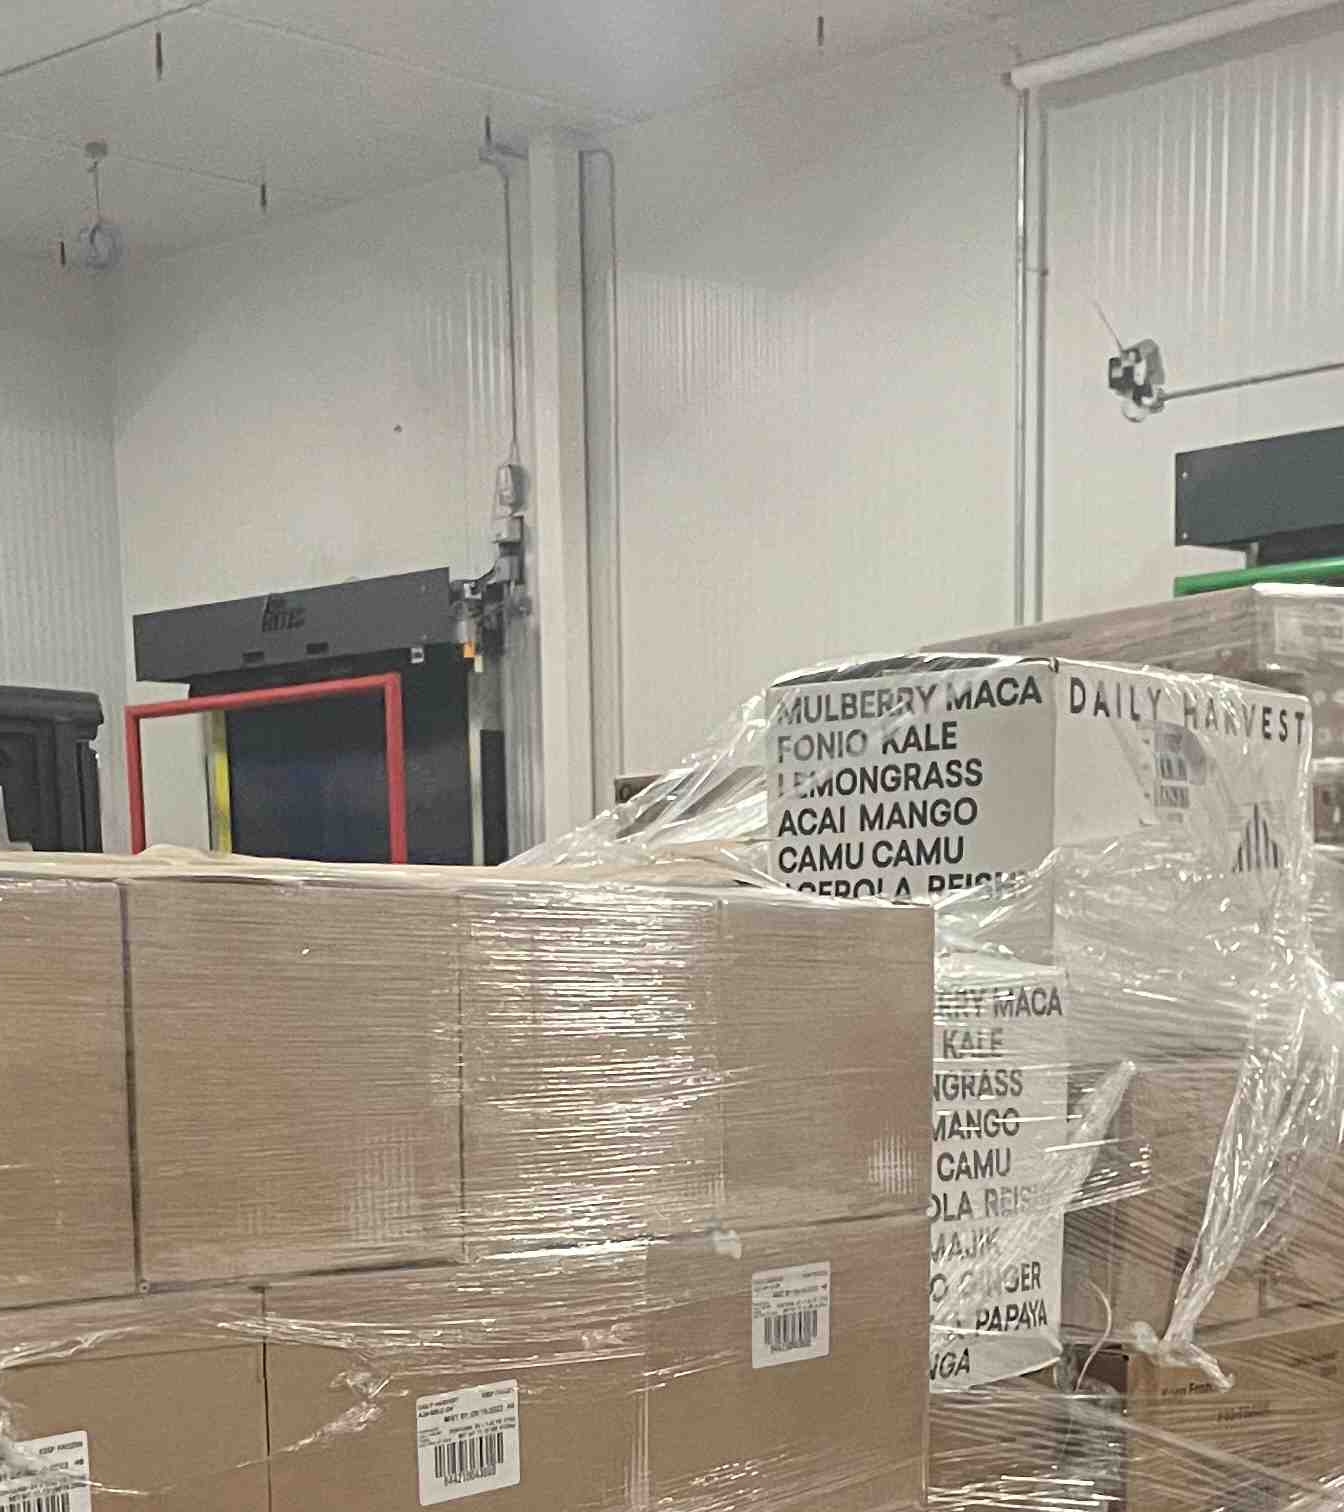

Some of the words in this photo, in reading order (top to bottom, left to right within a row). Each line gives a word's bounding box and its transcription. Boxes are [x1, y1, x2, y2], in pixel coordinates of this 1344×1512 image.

[777, 684, 937, 726] MULBERRY
[946, 675, 1043, 711] MACA
[1069, 677, 1162, 721] DAILY
[1183, 692, 1306, 745] HARVEST
[777, 728, 868, 764] FONIO
[881, 721, 959, 755] KALE
[777, 805, 846, 838] ACAI
[859, 797, 978, 833] MANGO
[778, 841, 865, 873] CAMU
[871, 836, 964, 868] CAMU
[992, 984, 1063, 1018] MACA
[943, 1027, 1004, 1060] KALE
[936, 1147, 1011, 1181] CAMU
[975, 1298, 1048, 1333] PAPAYA
